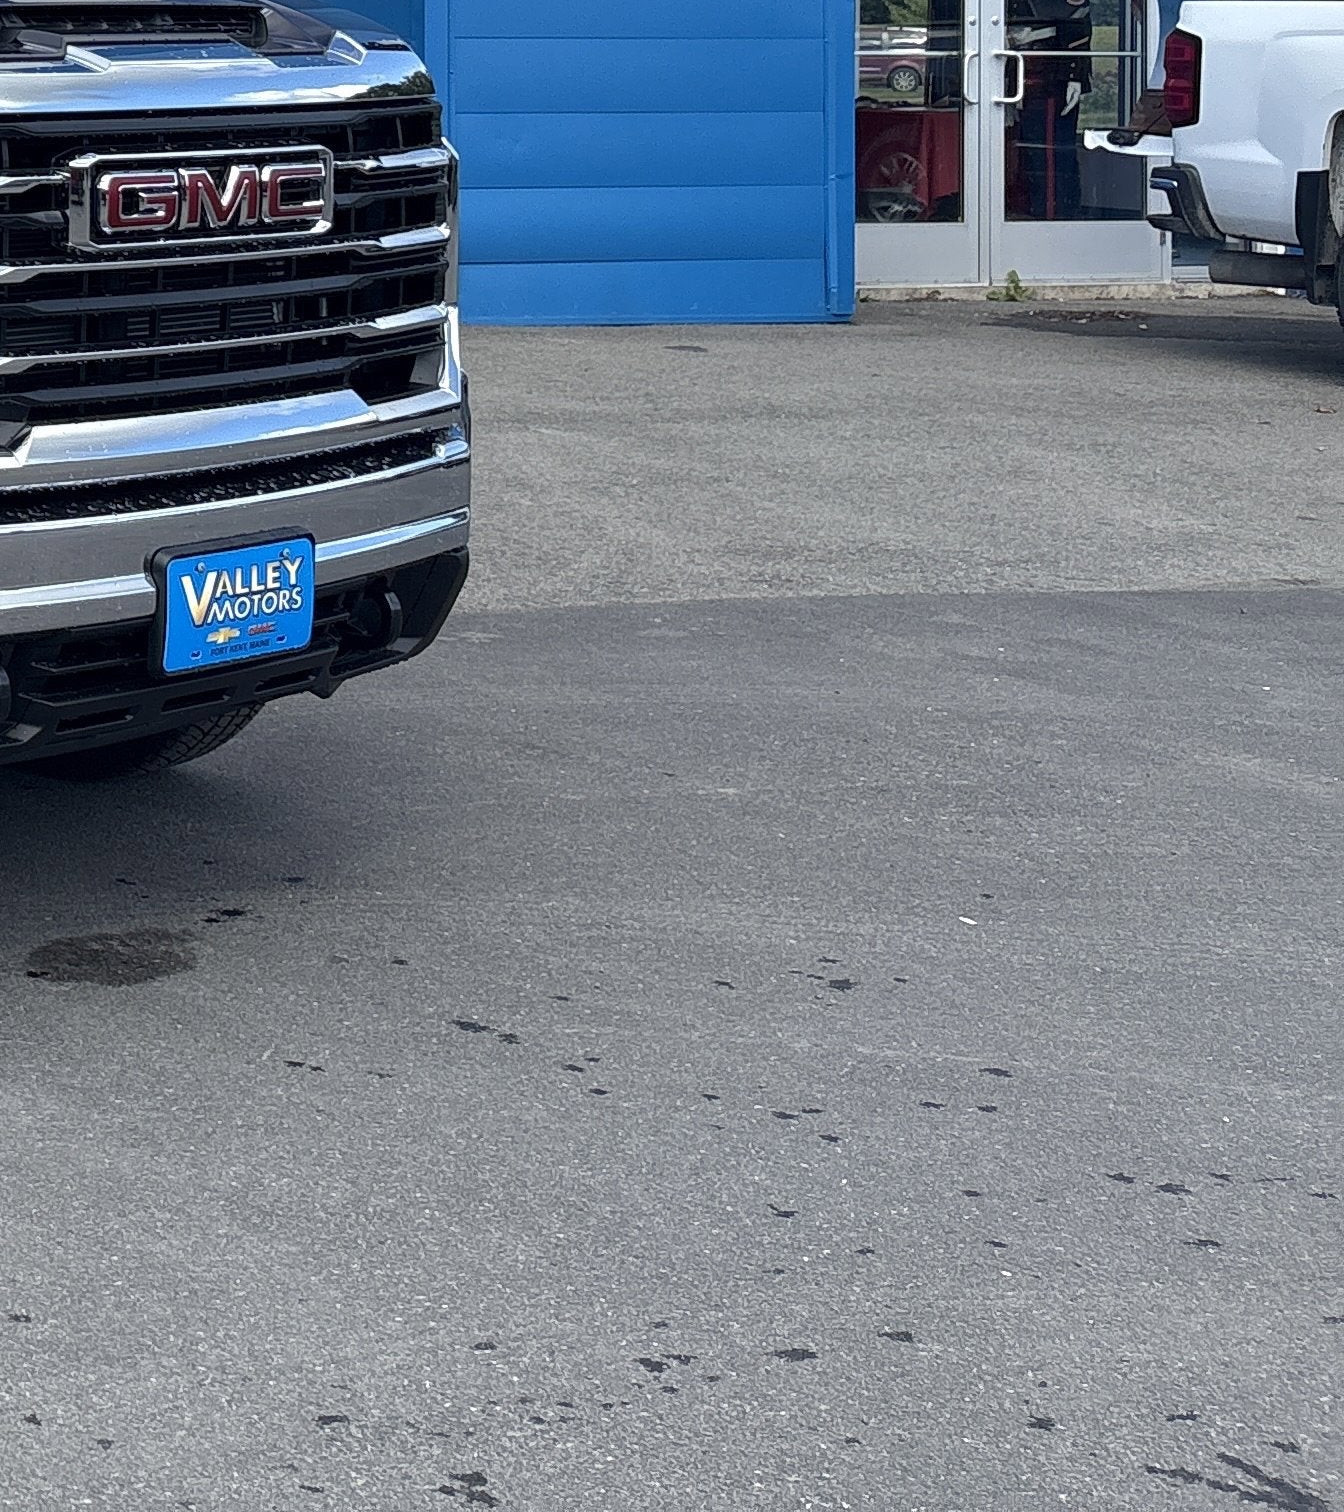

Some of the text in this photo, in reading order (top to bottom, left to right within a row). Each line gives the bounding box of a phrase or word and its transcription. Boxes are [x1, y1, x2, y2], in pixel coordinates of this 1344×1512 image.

[97, 163, 325, 234] GMC
[180, 556, 303, 626] VALLEY
[206, 586, 302, 624] MOTORS
